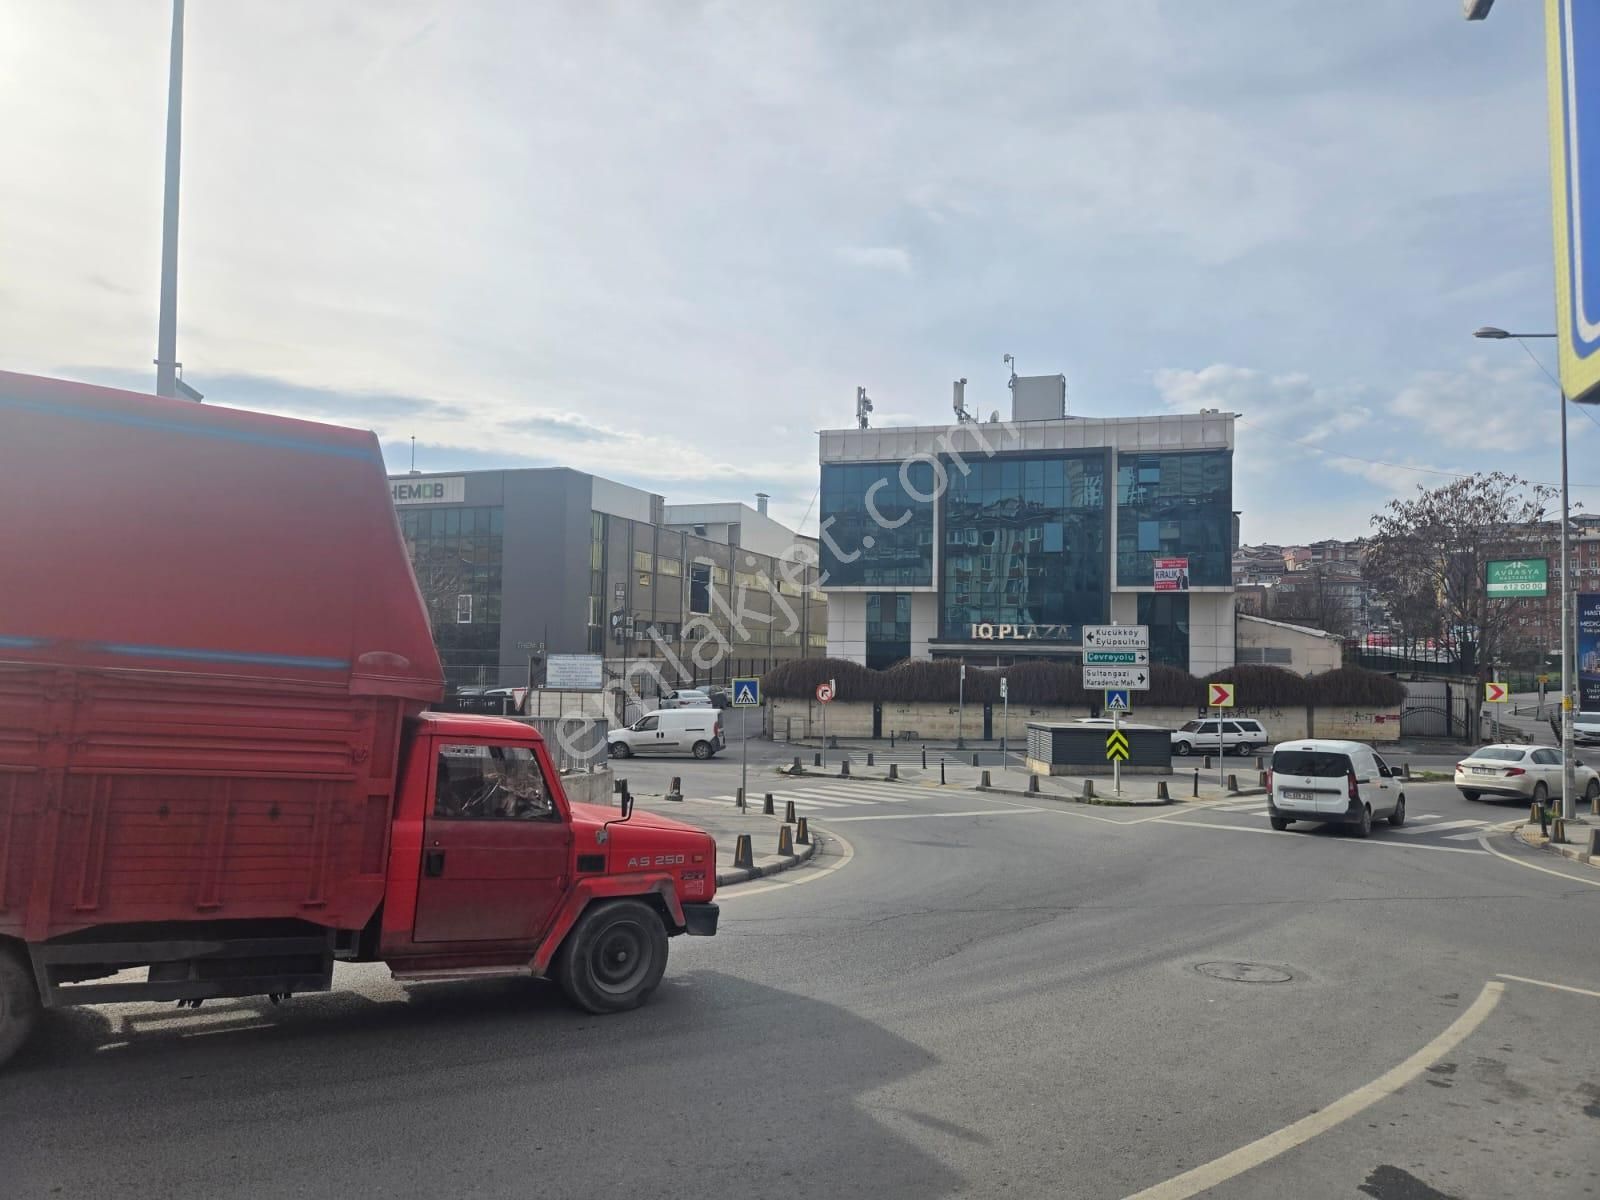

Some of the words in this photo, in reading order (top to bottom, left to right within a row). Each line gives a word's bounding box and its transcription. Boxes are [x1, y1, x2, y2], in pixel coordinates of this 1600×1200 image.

[1494, 568, 1540, 577] AVRASYA
[971, 623, 993, 640] IQ
[999, 623, 1069, 640] PLAZA
[1096, 638, 1146, 647] Eyüpsultan
[1086, 670, 1130, 679] Sultangazi
[628, 857, 650, 867] AS
[655, 854, 685, 865] 250
